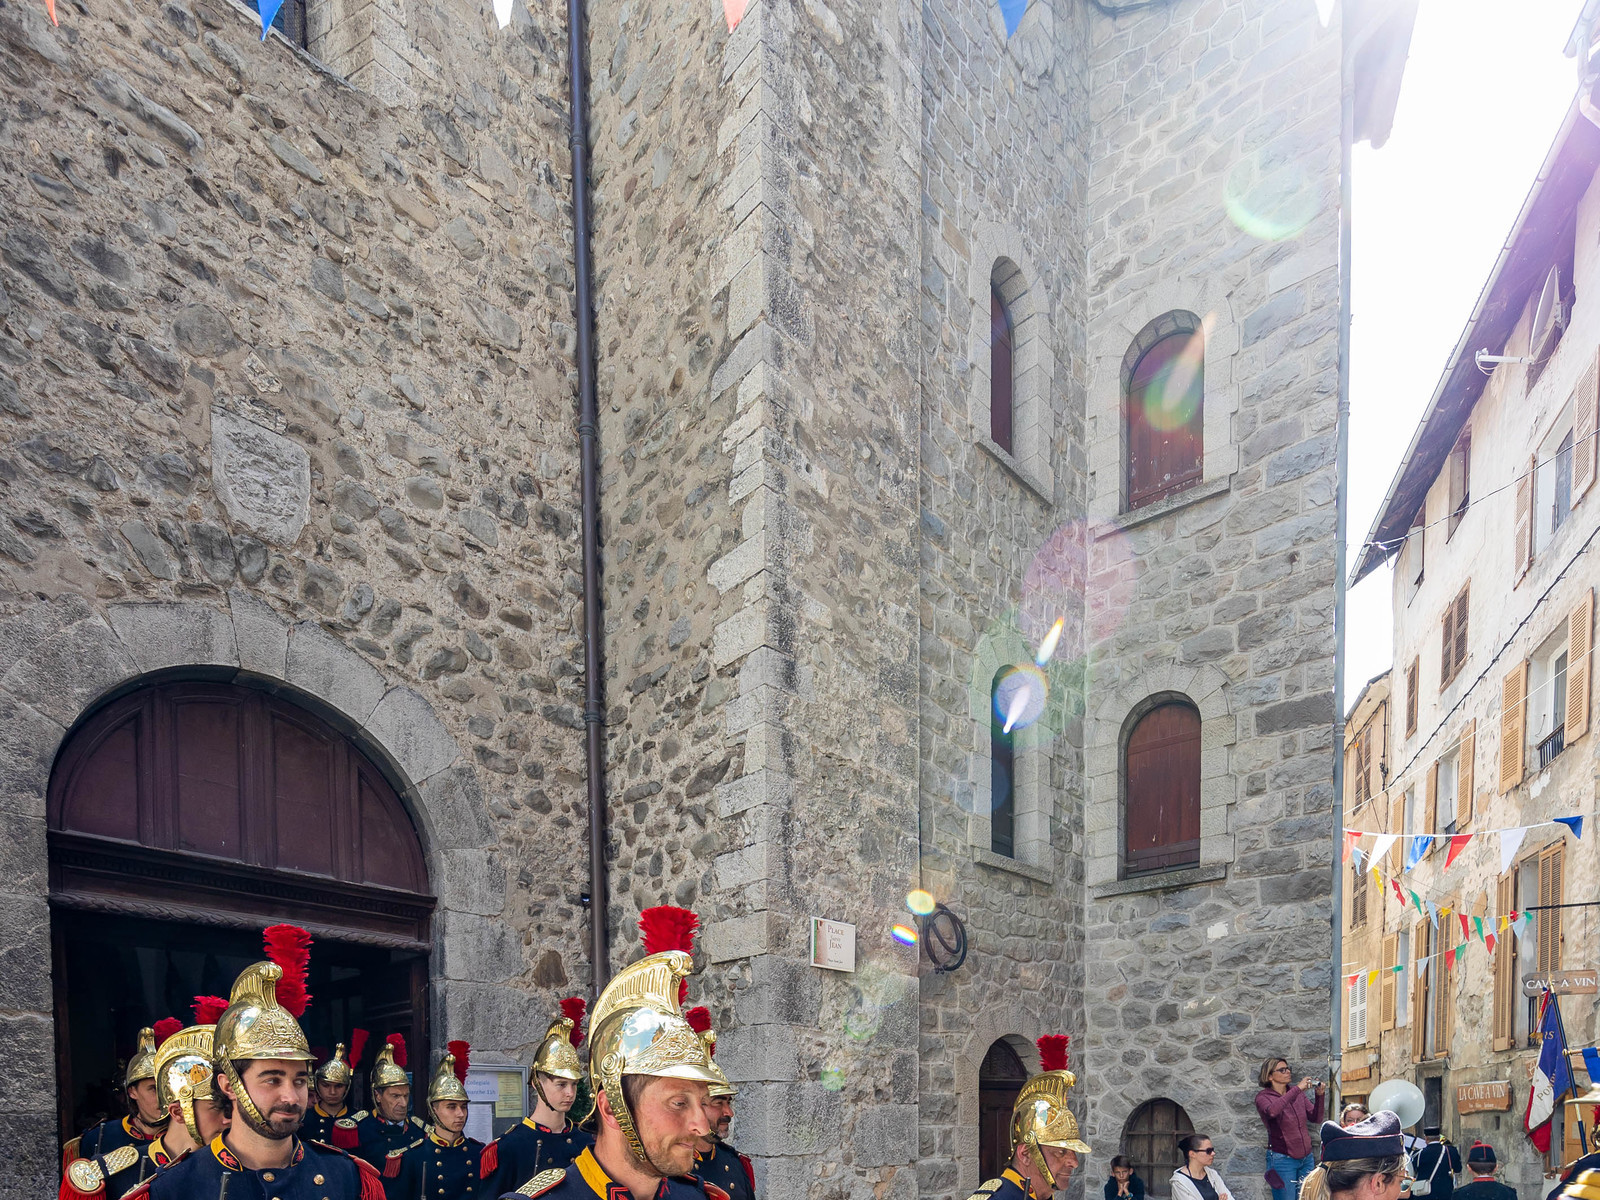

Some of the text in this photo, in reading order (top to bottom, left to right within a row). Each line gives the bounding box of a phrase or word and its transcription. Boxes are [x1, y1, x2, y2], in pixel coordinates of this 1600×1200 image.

[827, 924, 844, 935] PLACE
[1561, 979, 1569, 988] A
[1574, 977, 1596, 987] VIN
[1459, 1088, 1467, 1100] LA
[1468, 1086, 1485, 1100] CAVE
